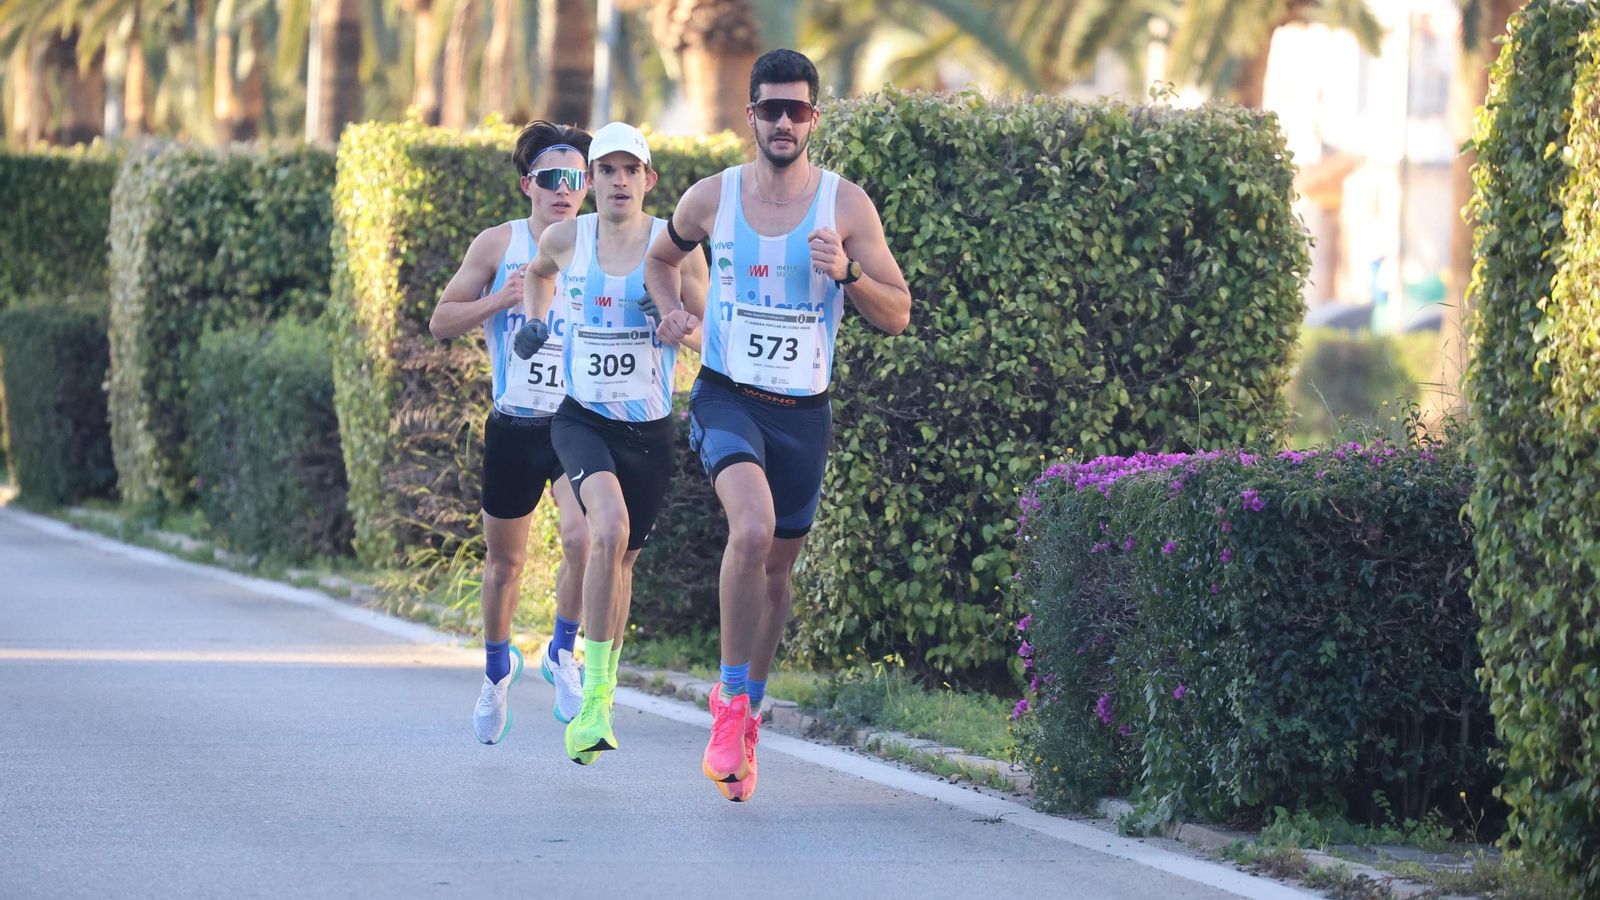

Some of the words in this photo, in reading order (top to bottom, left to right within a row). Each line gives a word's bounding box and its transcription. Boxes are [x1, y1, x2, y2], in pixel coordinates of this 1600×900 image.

[714, 241, 734, 250] vive
[568, 275, 586, 283] vive
[747, 333, 798, 362] 573
[527, 362, 564, 388] 51
[587, 353, 636, 377] 309
[743, 387, 797, 405] WONG
